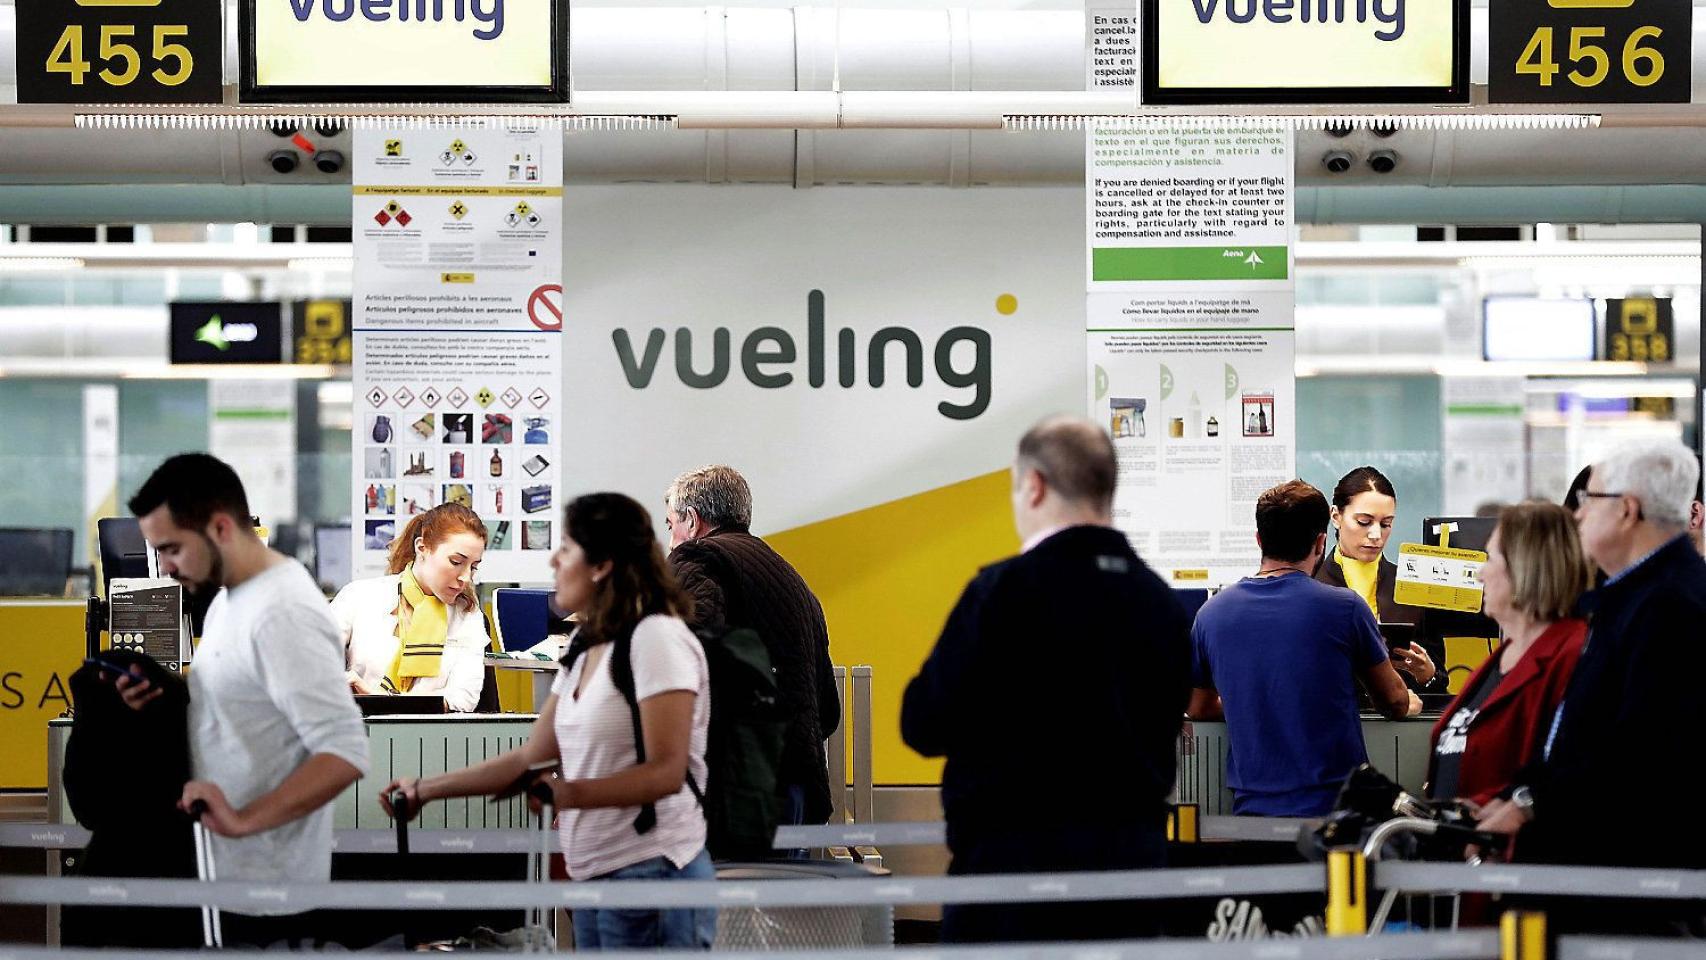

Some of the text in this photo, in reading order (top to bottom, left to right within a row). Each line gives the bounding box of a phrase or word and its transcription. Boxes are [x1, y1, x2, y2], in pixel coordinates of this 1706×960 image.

[1094, 16, 1108, 24] En
[46, 25, 193, 86] 455
[1516, 26, 1665, 88] 456
[1095, 127, 1147, 135] facturación
[1214, 127, 1225, 135] de
[1228, 127, 1274, 136] embarque
[1095, 138, 1120, 146] texto
[1140, 138, 1148, 146] el
[1152, 139, 1170, 147] que
[1174, 138, 1210, 147] figuran
[1095, 148, 1180, 157] especialmente
[1216, 147, 1260, 155] materia
[1271, 147, 1284, 155] de
[1095, 158, 1224, 168] compensación y asistencia.
[1095, 178, 1102, 186] If
[1103, 180, 1121, 188] you
[1140, 178, 1171, 186] denied
[1173, 178, 1215, 188] boarding
[1229, 177, 1235, 186] if
[1237, 179, 1258, 188] your
[1260, 176, 1284, 187] flight
[1095, 188, 1104, 197] is
[1108, 188, 1153, 197] cancelled
[1170, 188, 1208, 198] delayed
[1211, 188, 1225, 196] for
[1228, 188, 1237, 196] at
[1240, 188, 1264, 196] least
[1267, 188, 1285, 196] two
[1095, 199, 1127, 208] hours,
[1131, 198, 1148, 207] ask
[1152, 199, 1162, 207] at
[1166, 199, 1182, 207] the
[1186, 198, 1228, 206] check-in
[1232, 198, 1270, 206] counter
[1095, 209, 1139, 219] boarding
[1142, 210, 1163, 219] gate
[1168, 209, 1181, 217] for
[1204, 208, 1221, 216] text
[1226, 208, 1259, 217] stating
[1262, 209, 1285, 217] your
[1095, 218, 1285, 229] rights, particularly with regard to
[1095, 229, 1236, 239] compensation and assistance.
[1223, 250, 1244, 258] Aena
[398, 306, 434, 314] peligrosos
[436, 306, 473, 314] prohibidos
[612, 289, 992, 420] vueling
[1099, 376, 1106, 388] 1
[1162, 375, 1170, 388] 2
[1228, 375, 1236, 388] 3
